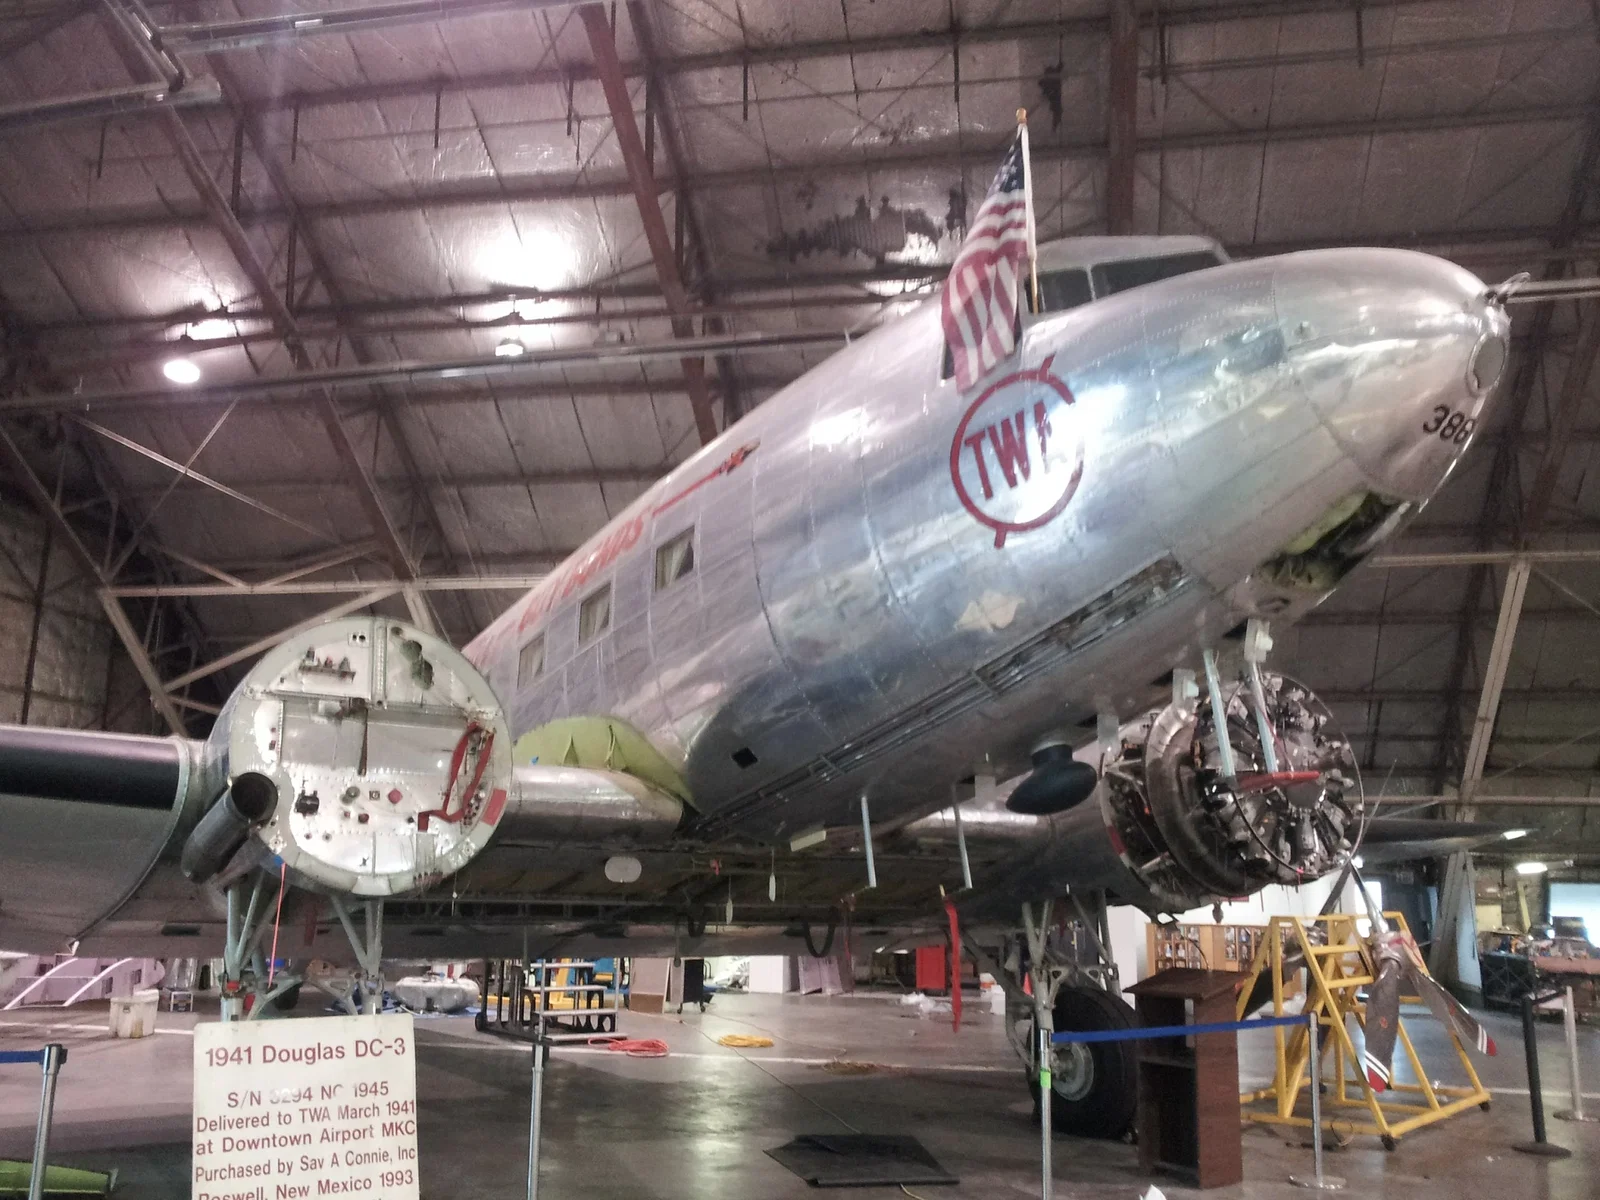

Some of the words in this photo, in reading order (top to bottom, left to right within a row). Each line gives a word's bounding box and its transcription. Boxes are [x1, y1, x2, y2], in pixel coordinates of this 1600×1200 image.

[206, 1047, 252, 1067] 1941
[262, 1042, 345, 1065] Douglas
[355, 1037, 405, 1057] DC-3
[227, 1090, 262, 1109] S/N
[354, 1081, 389, 1097] 1945
[196, 1113, 270, 1132] Delivered
[278, 1112, 292, 1125] to
[299, 1107, 331, 1123] TWA
[337, 1104, 380, 1120] March
[386, 1100, 415, 1115] 1941
[196, 1141, 213, 1155] at
[222, 1132, 312, 1152] Downtown
[320, 1125, 374, 1144] Airport
[382, 1120, 415, 1137] MKC
[195, 1160, 271, 1182] Purchased
[278, 1159, 293, 1176] by
[300, 1156, 324, 1171] Sav
[331, 1153, 339, 1168] A
[345, 1148, 392, 1166] Connie,
[398, 1146, 416, 1160] Inc
[276, 1184, 310, 1200] New
[318, 1178, 372, 1195] Mexico
[379, 1170, 413, 1186] 1993
